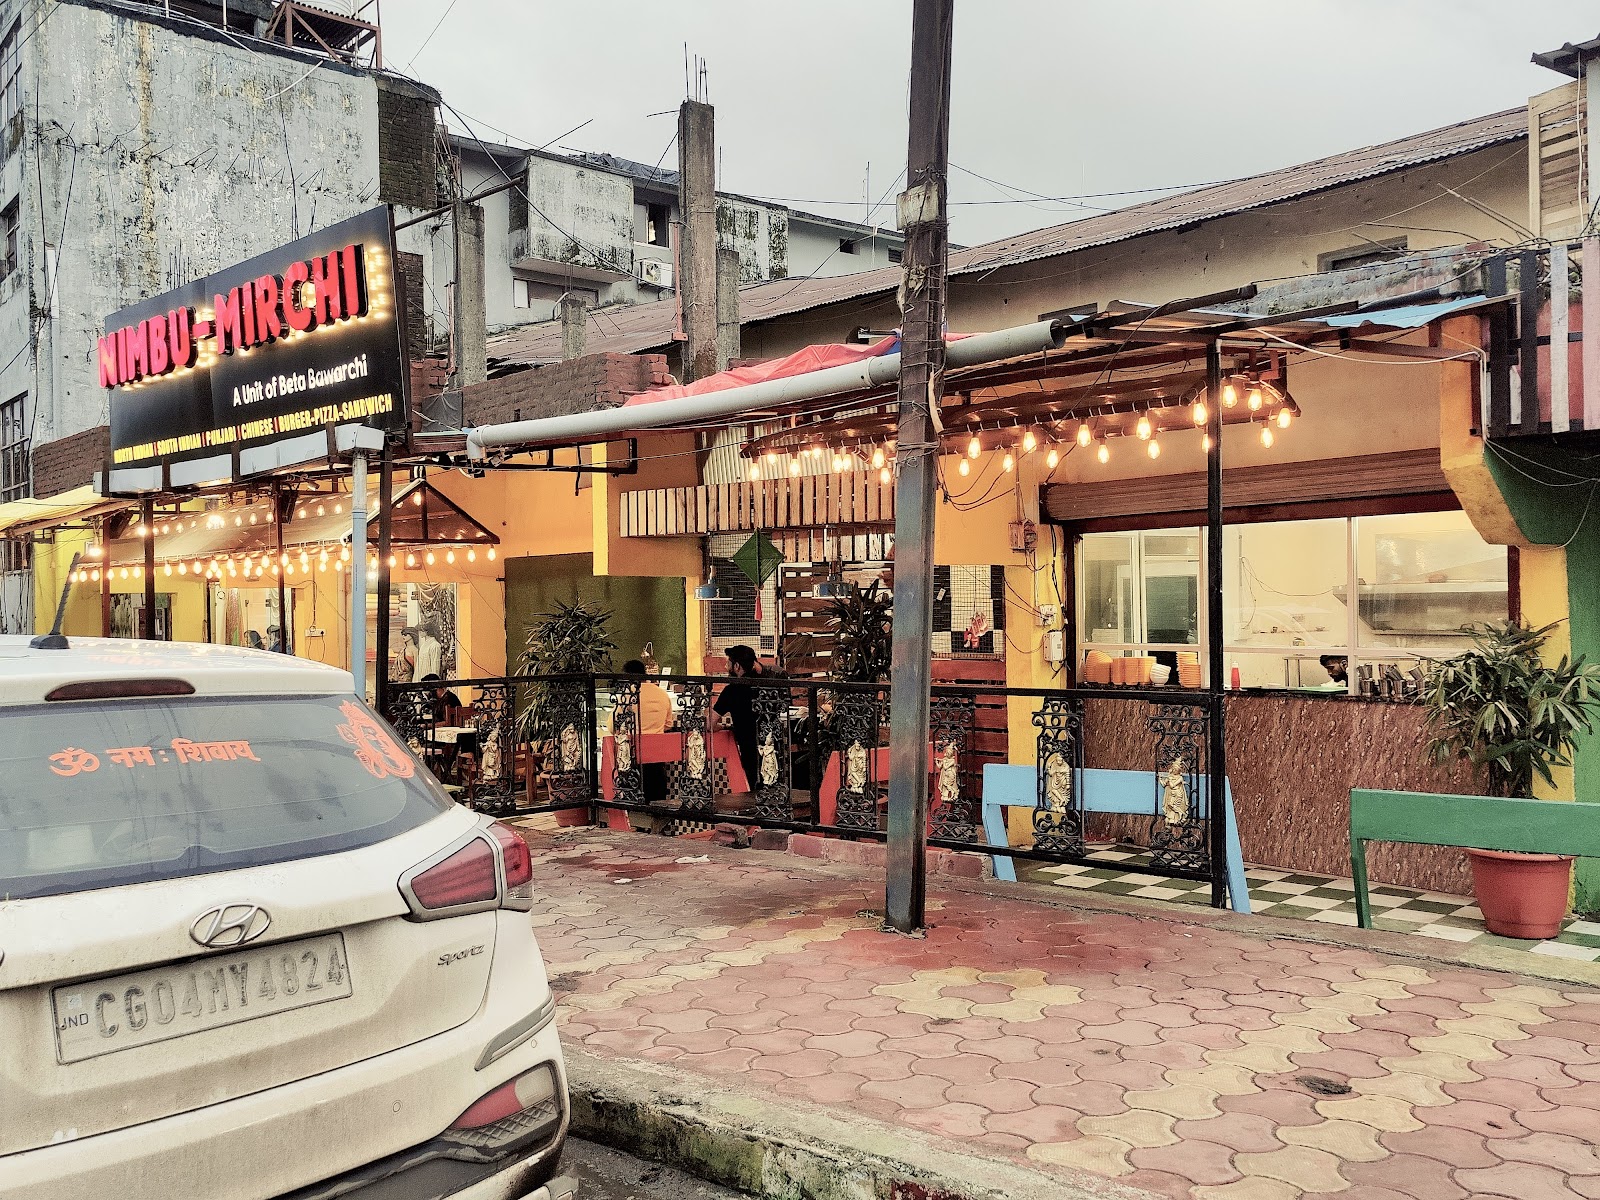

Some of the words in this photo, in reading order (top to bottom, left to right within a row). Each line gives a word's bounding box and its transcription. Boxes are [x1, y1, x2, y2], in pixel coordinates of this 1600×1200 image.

[98, 243, 368, 389] NIMBU-MIRCHI
[233, 387, 241, 407] A
[242, 381, 264, 405] Unit
[265, 376, 278, 398] of
[279, 371, 306, 396] Beta
[308, 353, 368, 389] Bawarchi
[133, 443, 154, 461] INDIAN
[157, 438, 178, 456] SOUTH
[178, 433, 202, 452] INDIAN
[205, 426, 237, 446] PUNJABI
[241, 418, 274, 440] CHINESE
